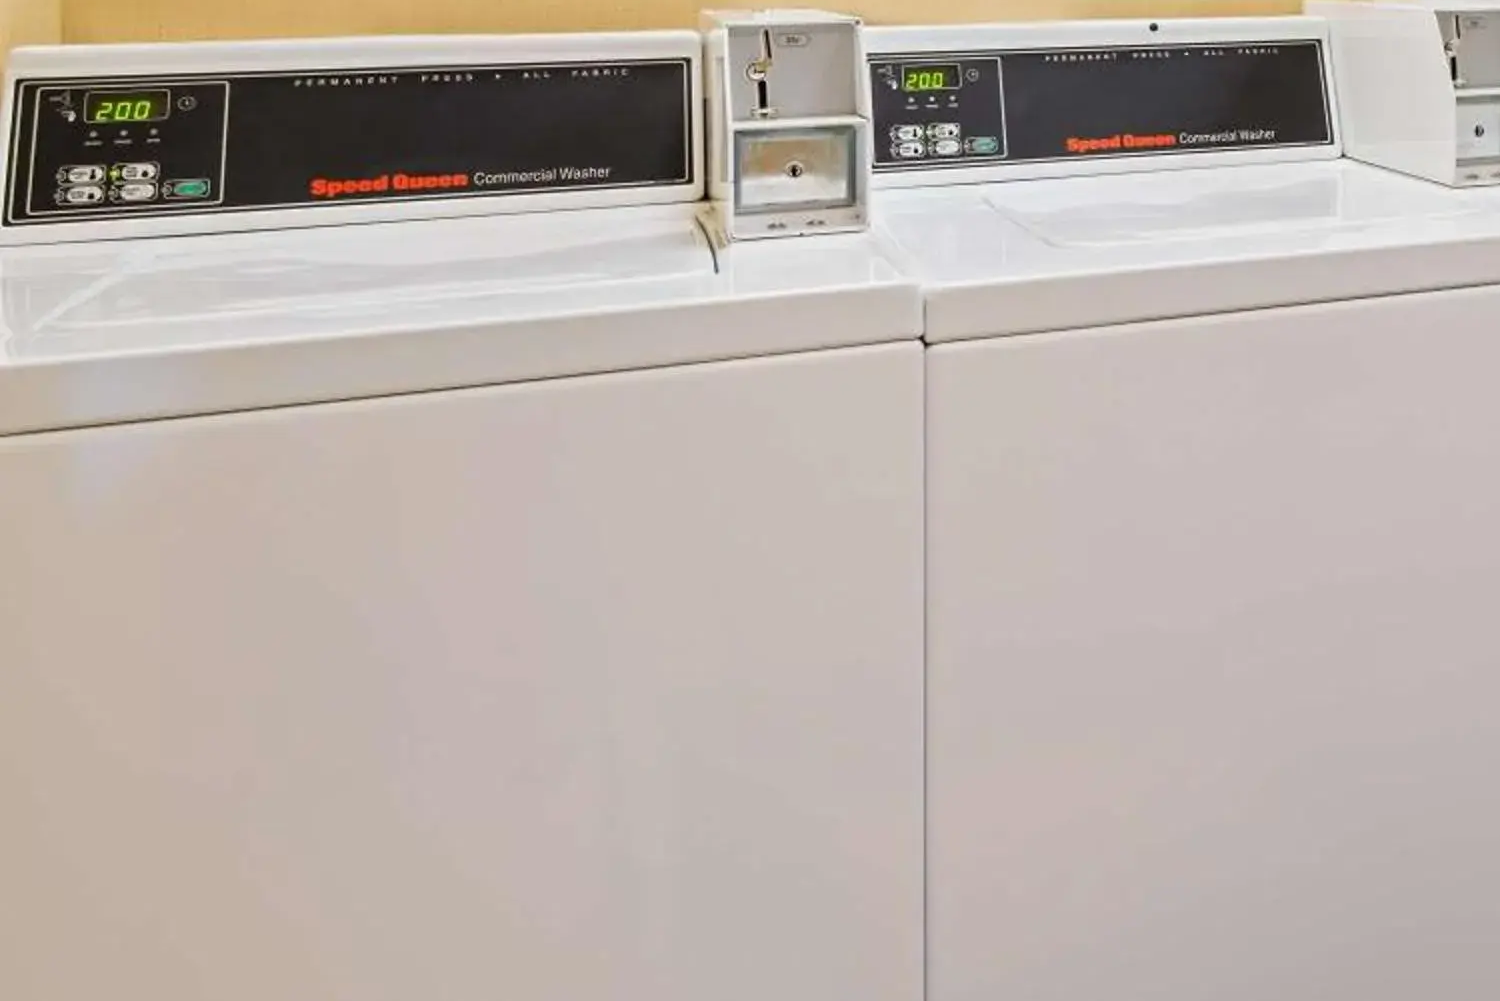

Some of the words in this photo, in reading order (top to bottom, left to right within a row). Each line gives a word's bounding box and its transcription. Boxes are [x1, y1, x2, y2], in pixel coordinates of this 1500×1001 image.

[293, 76, 399, 87] PERMANENT
[420, 73, 474, 83] PRESS
[522, 70, 551, 79] ALL
[570, 67, 630, 78] FABRIC
[906, 72, 944, 89] 200
[95, 100, 151, 122] 200
[1066, 135, 1121, 152] Speed
[1122, 133, 1176, 148] Queen
[1179, 130, 1236, 144] Commercial
[1239, 128, 1276, 141] Washer
[310, 174, 389, 197] Speed
[392, 171, 470, 191] Queen
[473, 167, 557, 186] Commercial
[558, 165, 611, 181] Washer
